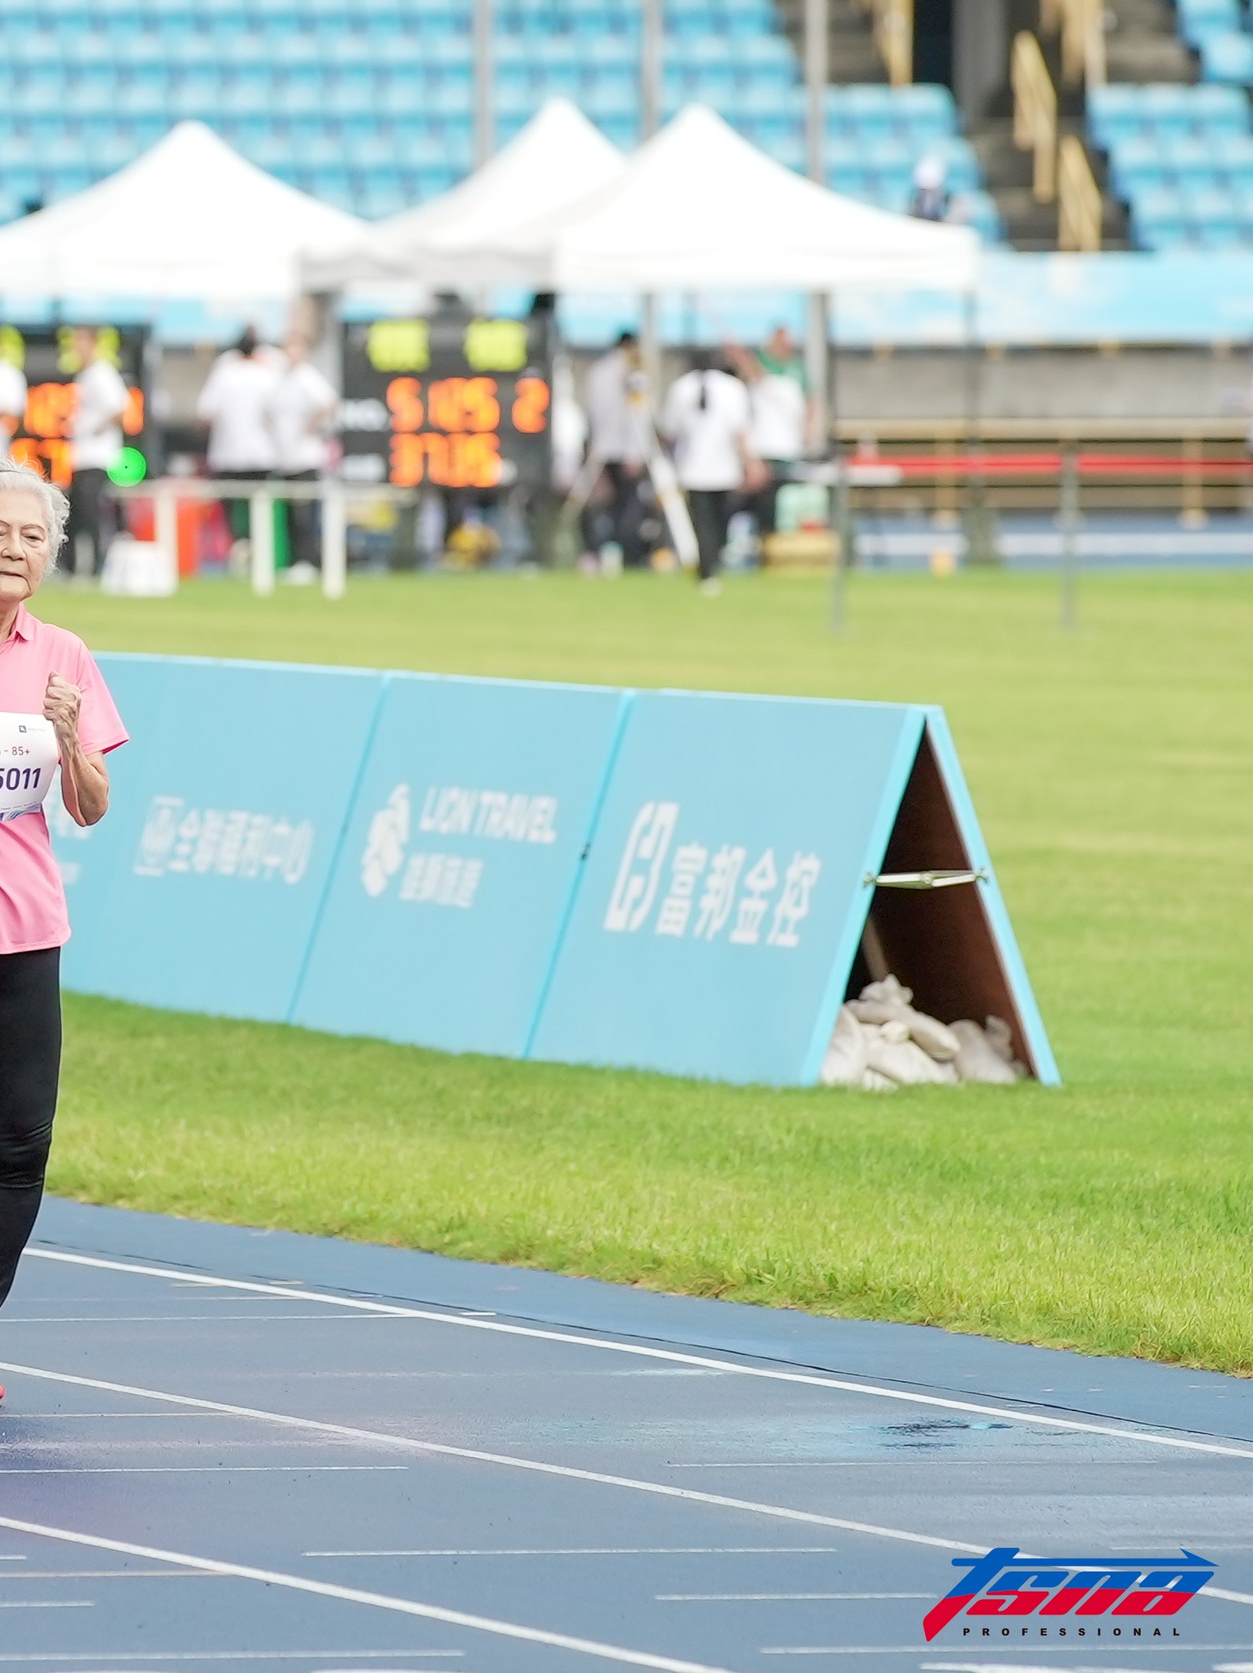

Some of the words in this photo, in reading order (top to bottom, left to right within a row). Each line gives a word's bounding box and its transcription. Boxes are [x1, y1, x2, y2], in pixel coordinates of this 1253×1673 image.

[11, 746, 30, 756] 85+
[655, 842, 821, 948] 富邦金控
